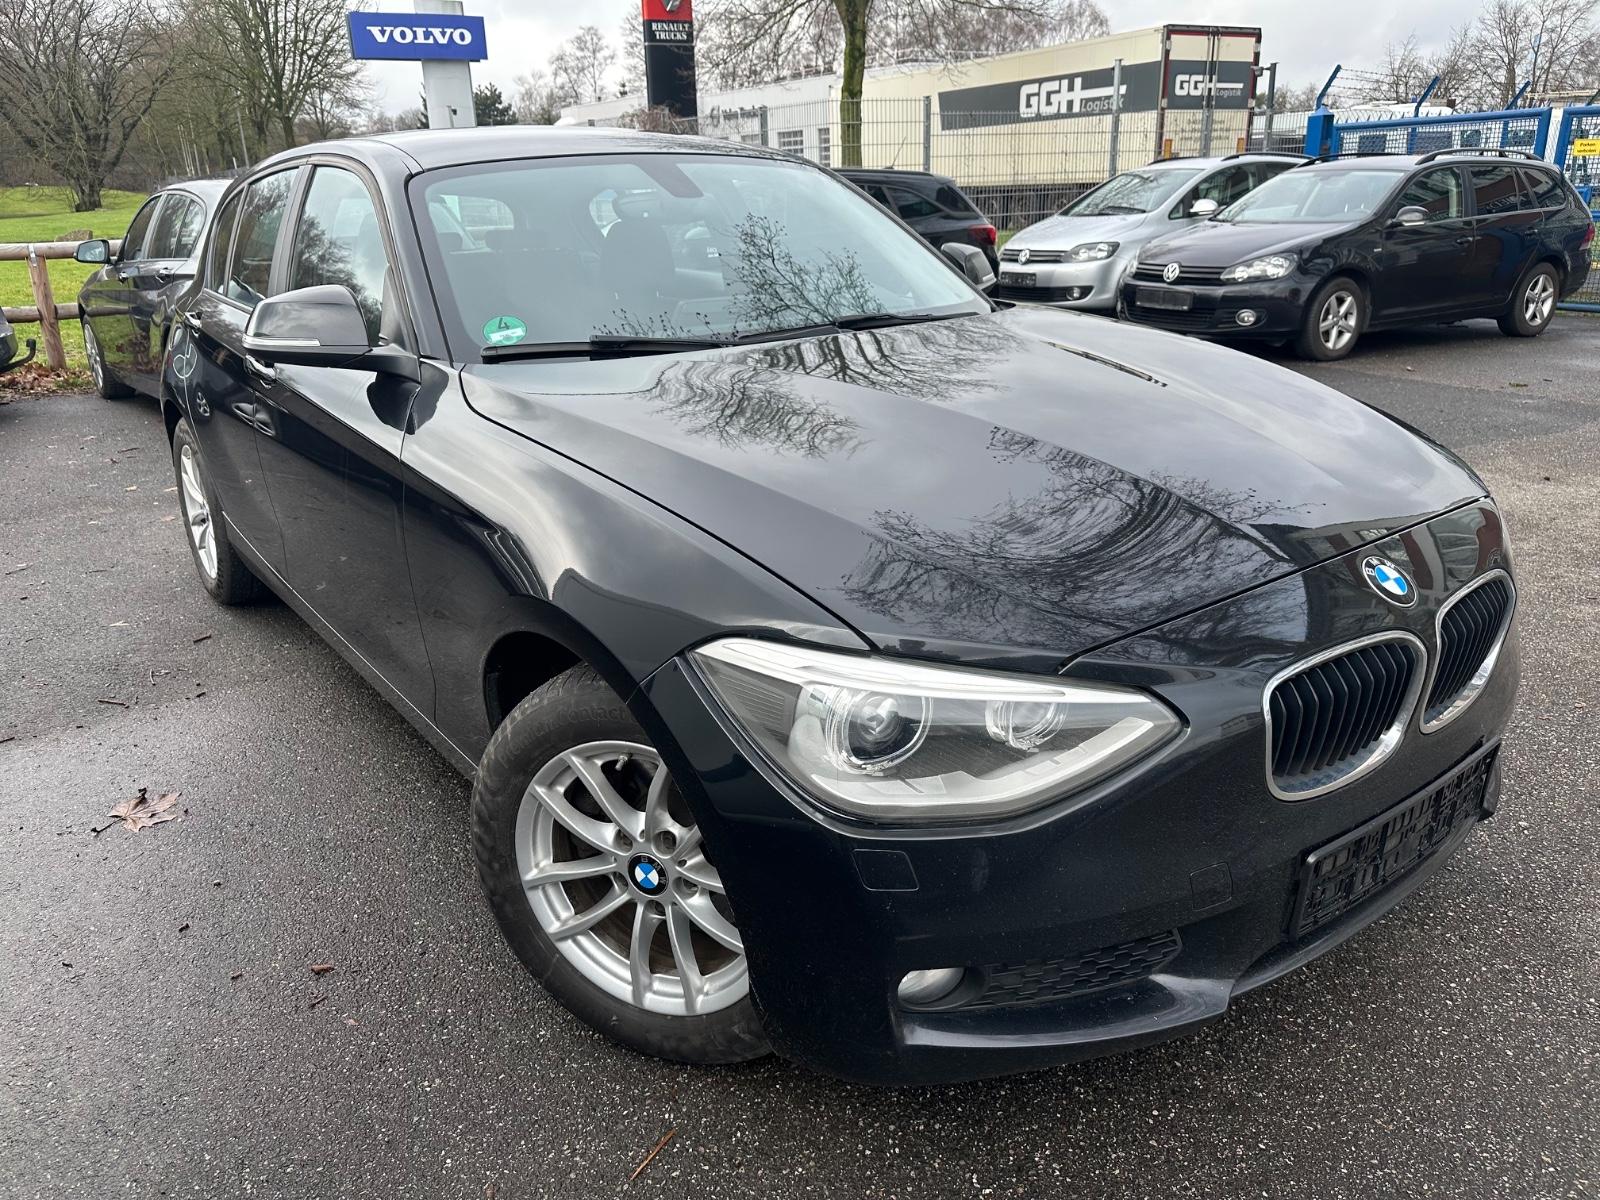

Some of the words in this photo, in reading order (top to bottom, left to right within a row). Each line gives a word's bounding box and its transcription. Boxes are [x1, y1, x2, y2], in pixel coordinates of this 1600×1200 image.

[366, 26, 472, 45] VOLVO
[651, 22, 690, 31] RENAULT
[655, 31, 687, 40] TRUCKS
[1174, 74, 1216, 96] GGH
[1019, 77, 1082, 118] GGH
[1081, 97, 1124, 113] Logistk
[498, 317, 510, 330] 4
[1365, 557, 1396, 576] BMW
[641, 855, 667, 885] BMW
